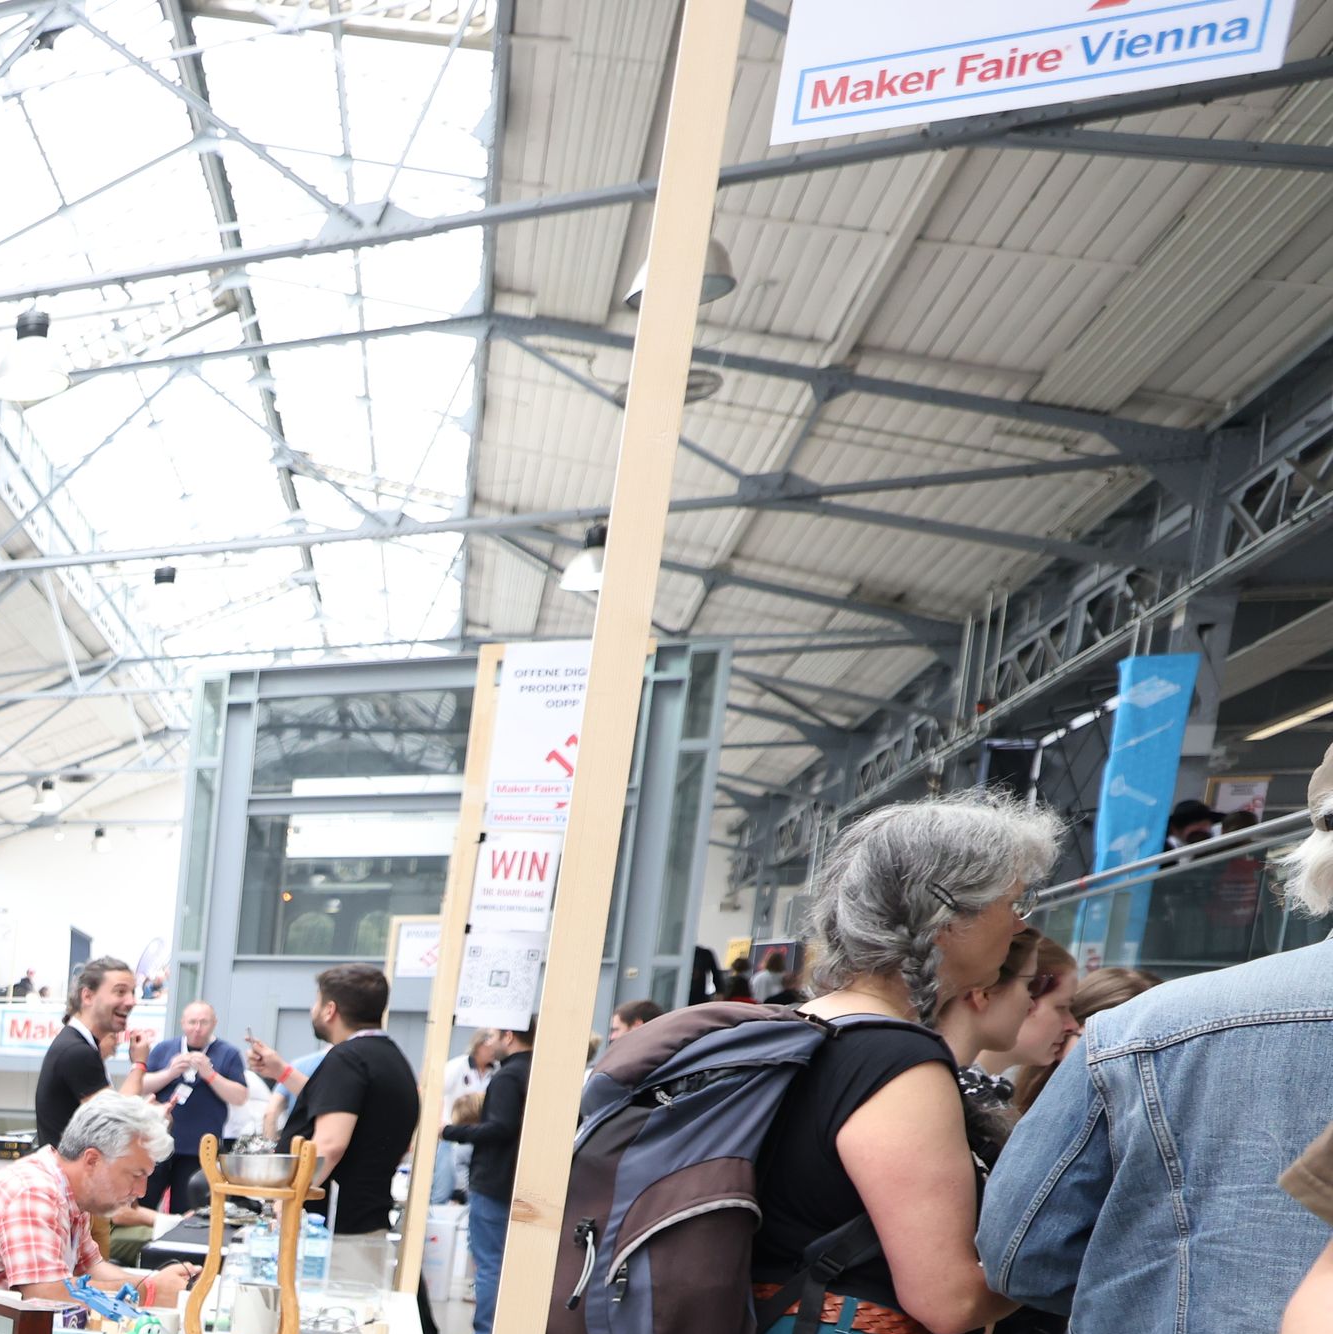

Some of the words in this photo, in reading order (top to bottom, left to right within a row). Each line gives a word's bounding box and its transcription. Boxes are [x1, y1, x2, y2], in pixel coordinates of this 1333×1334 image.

[809, 65, 951, 110] Maker
[955, 44, 1064, 87] Faire
[1080, 13, 1249, 67] Vienna
[490, 850, 550, 882] WIN
